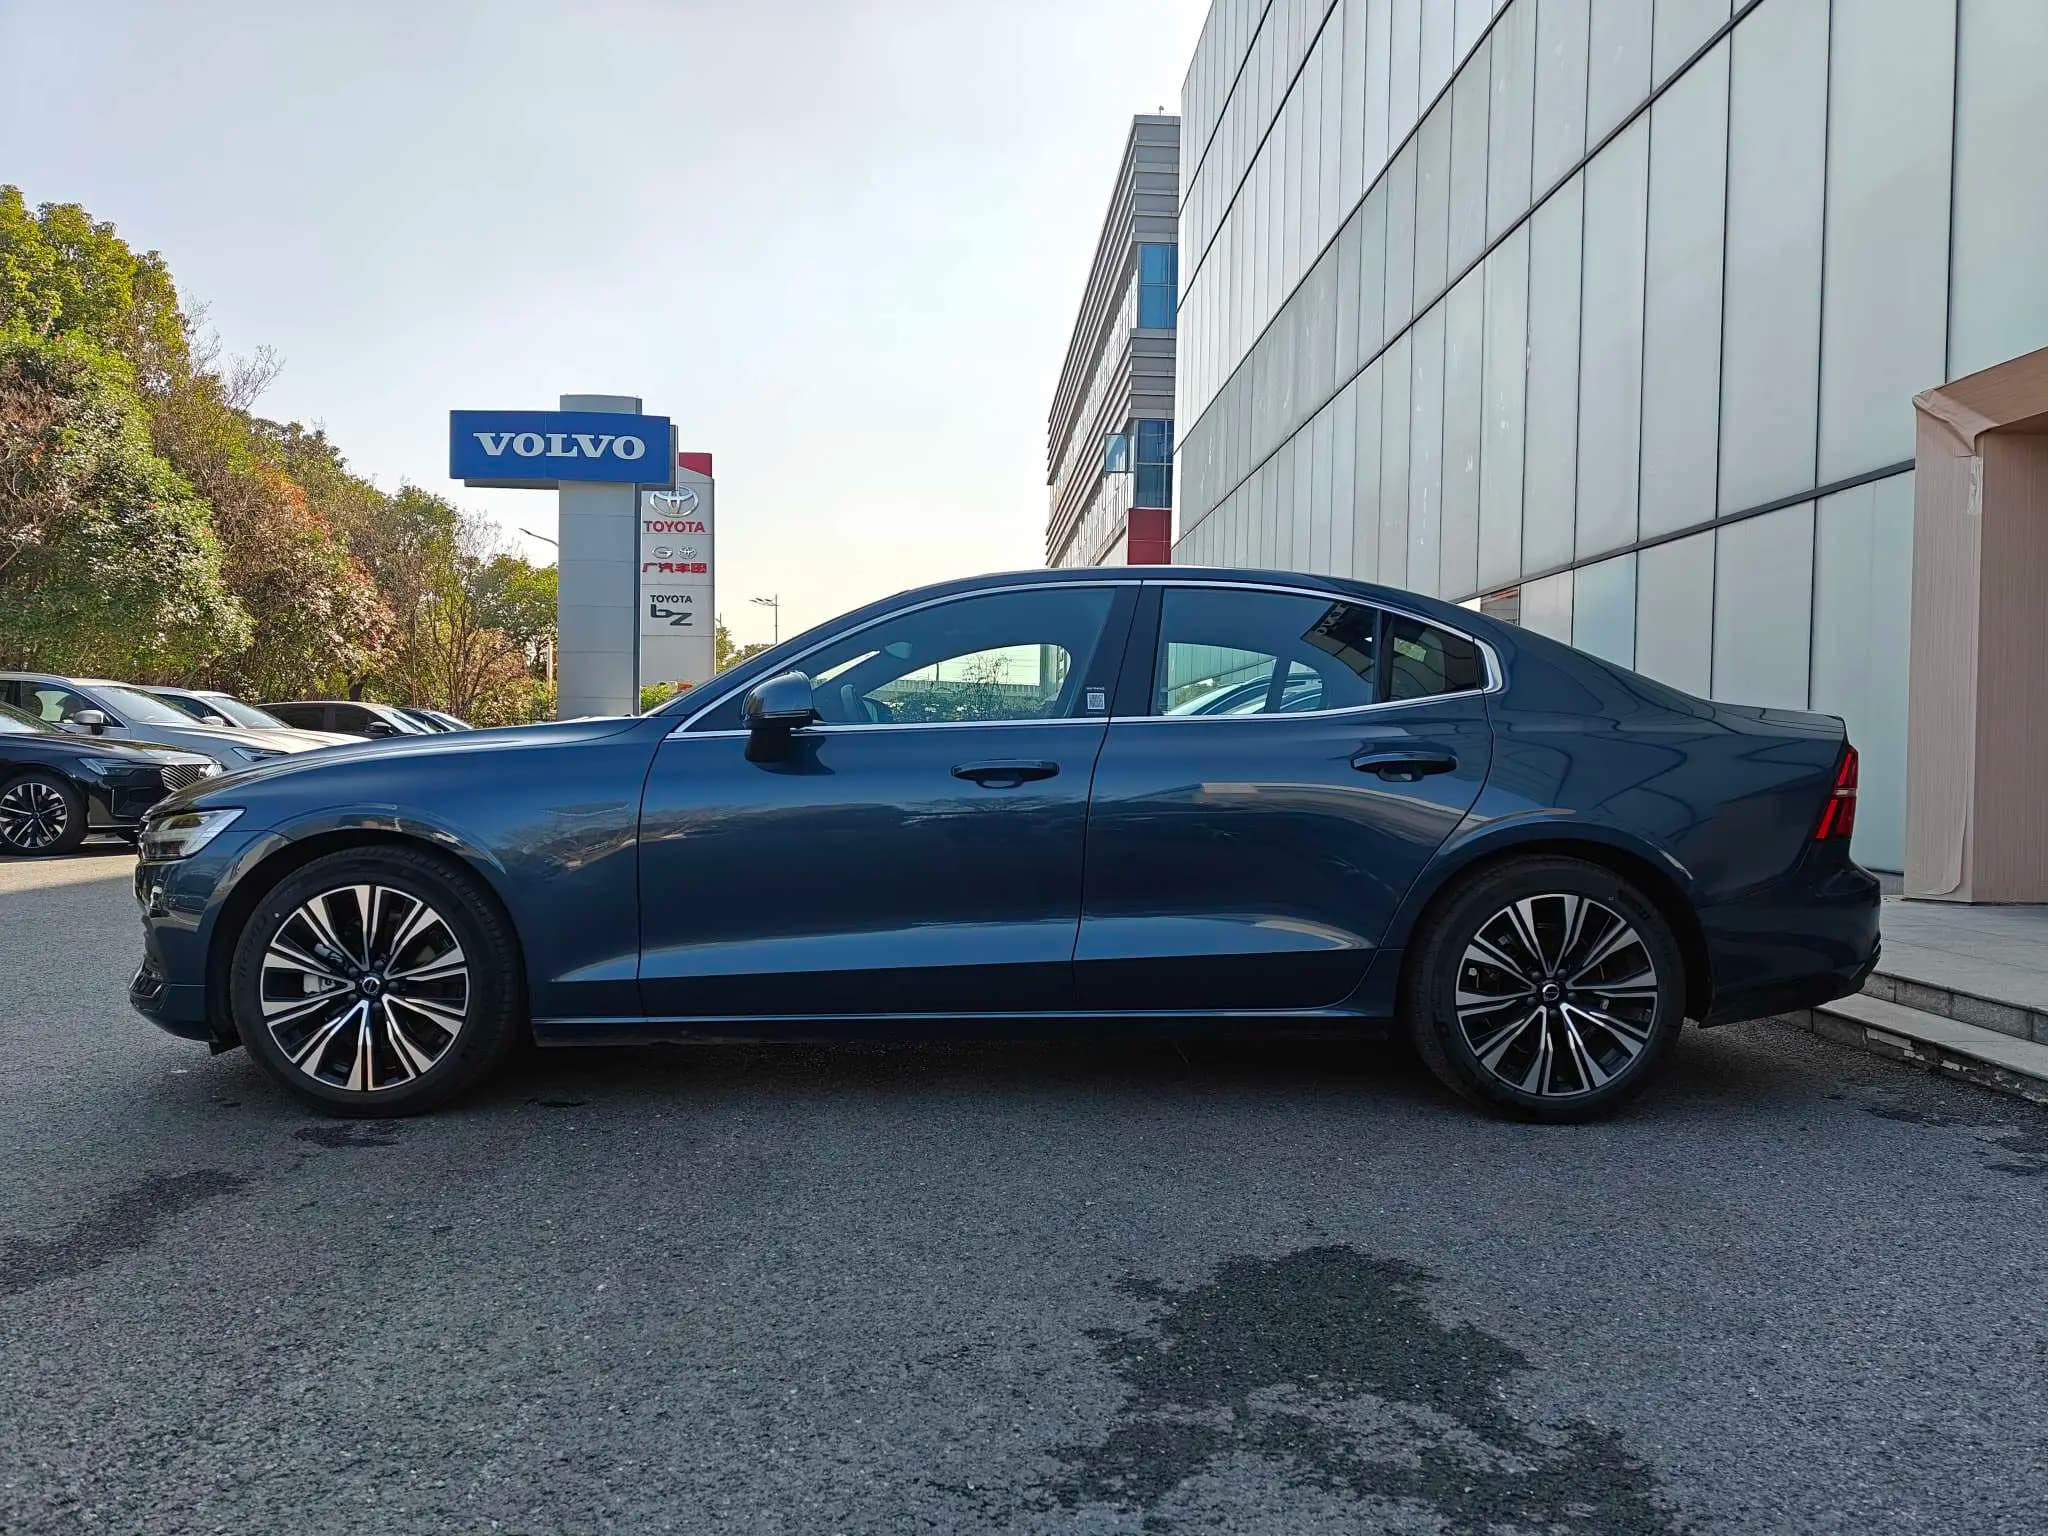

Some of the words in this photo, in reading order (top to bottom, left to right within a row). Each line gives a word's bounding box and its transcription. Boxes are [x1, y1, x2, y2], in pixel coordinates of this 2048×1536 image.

[473, 432, 646, 460] VOLVO
[643, 520, 706, 533] TOYOTA
[650, 594, 693, 604] TOYOTA
